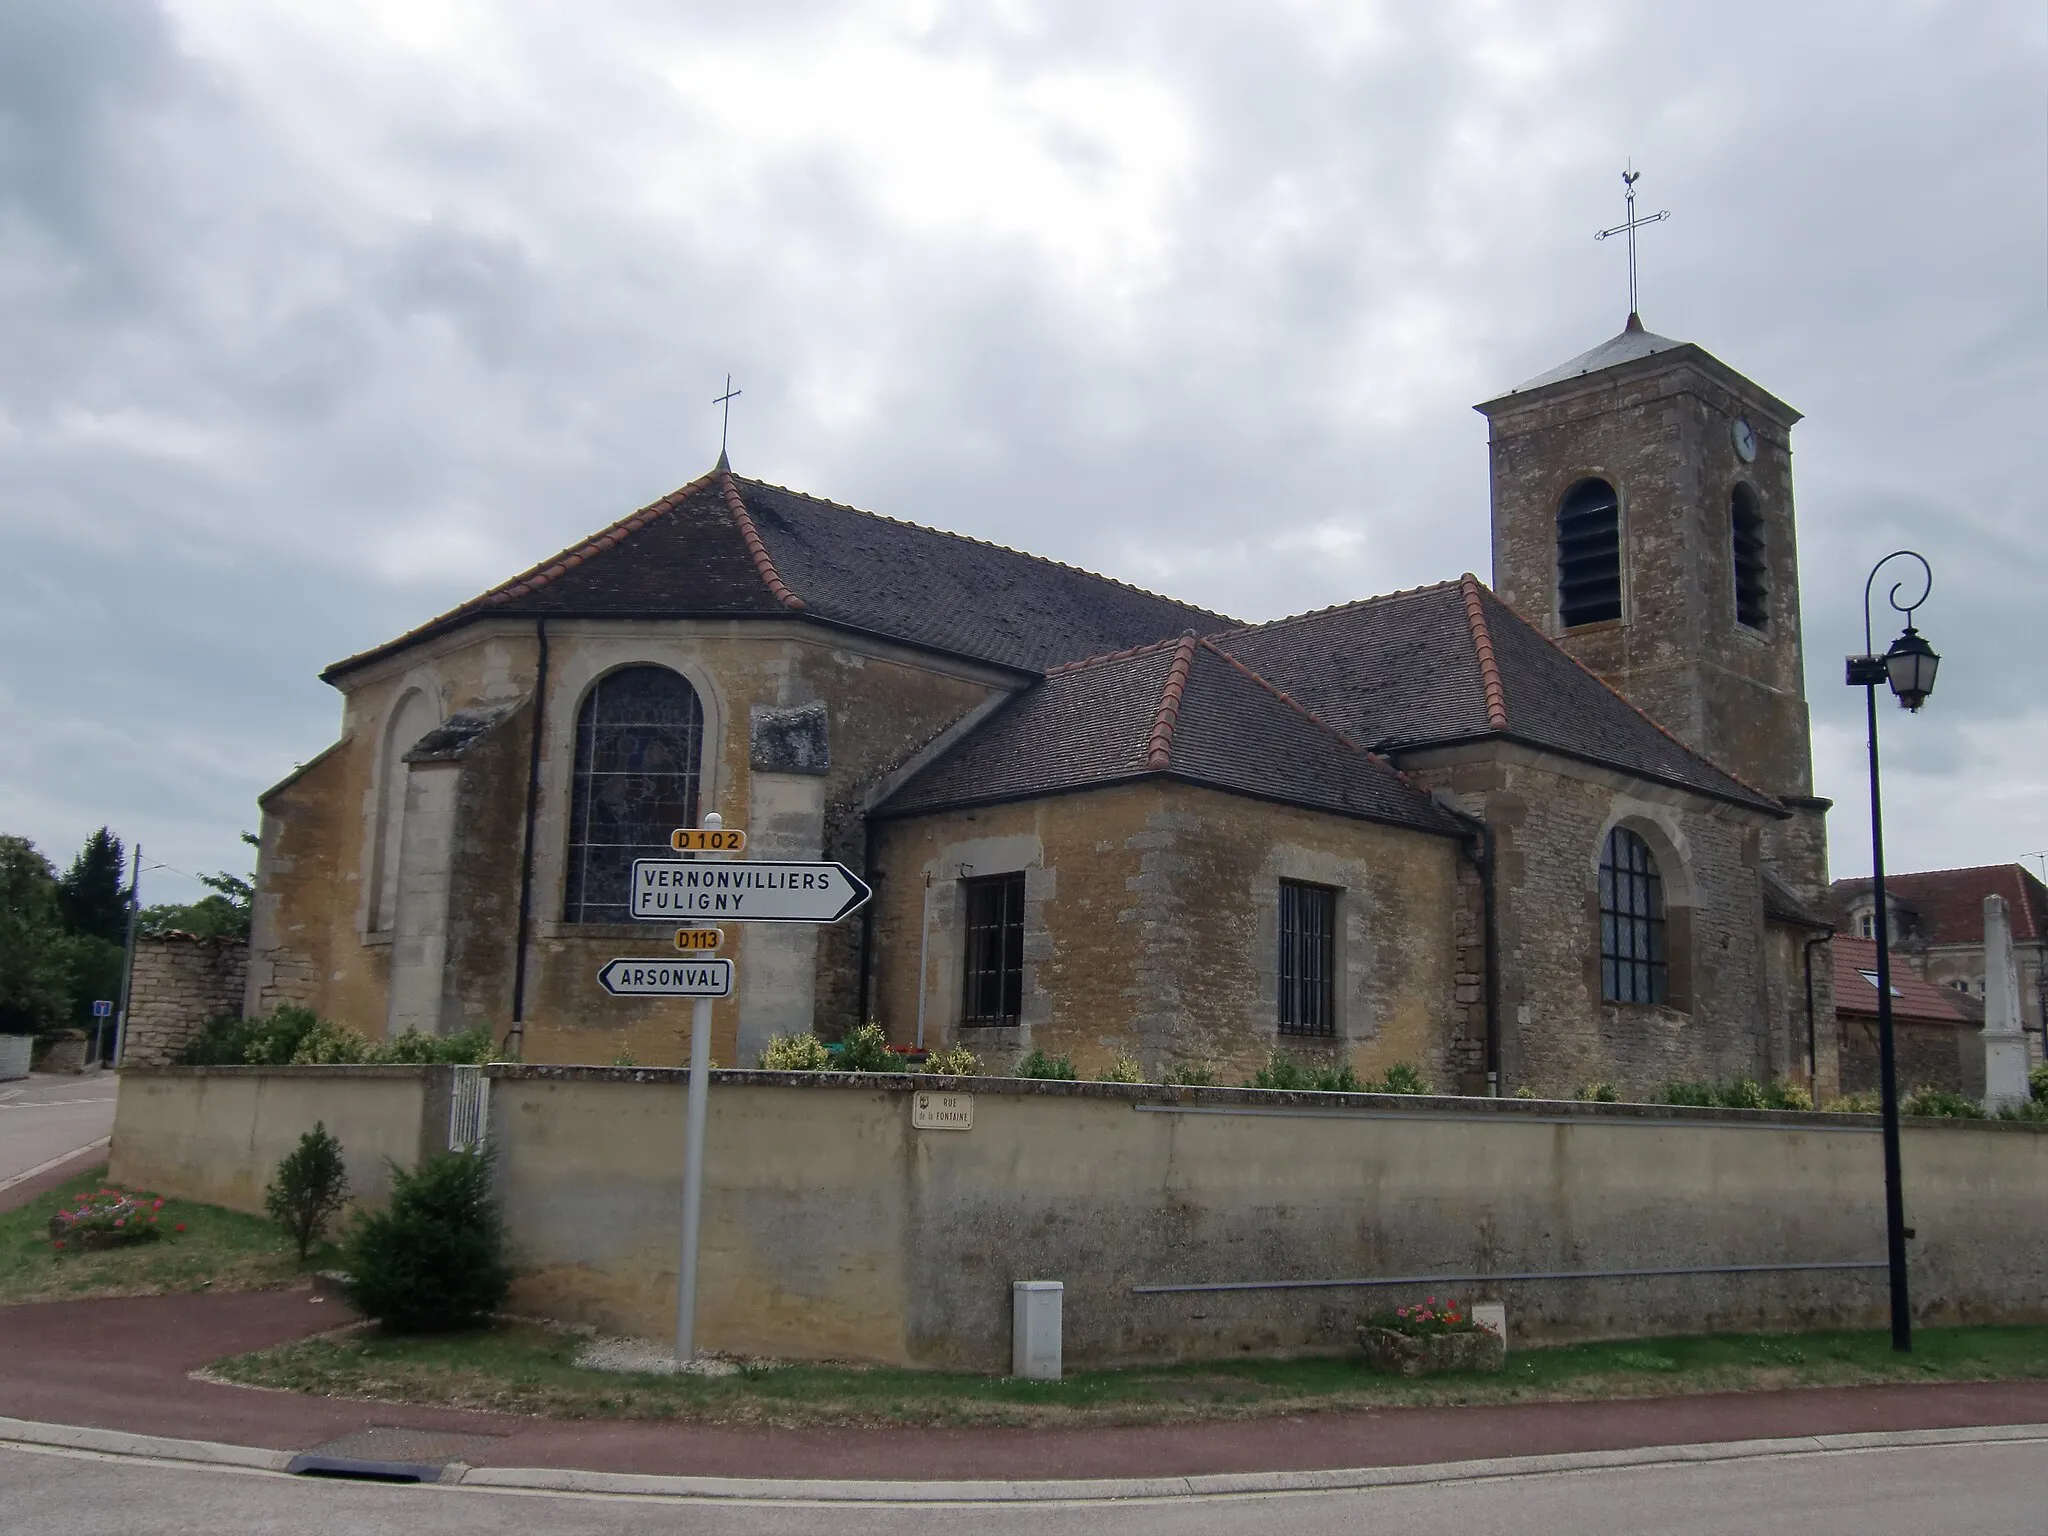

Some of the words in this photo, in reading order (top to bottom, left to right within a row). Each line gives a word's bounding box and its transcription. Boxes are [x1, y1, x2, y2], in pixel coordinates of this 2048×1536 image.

[678, 833, 690, 848] D
[699, 833, 739, 849] 102
[644, 870, 830, 889] VERNONVILLIERS
[642, 892, 744, 910] FULIGNY
[620, 969, 720, 986] ARSONVAL
[943, 1098, 957, 1107] RUE
[936, 1112, 967, 1121] FONTAINE
